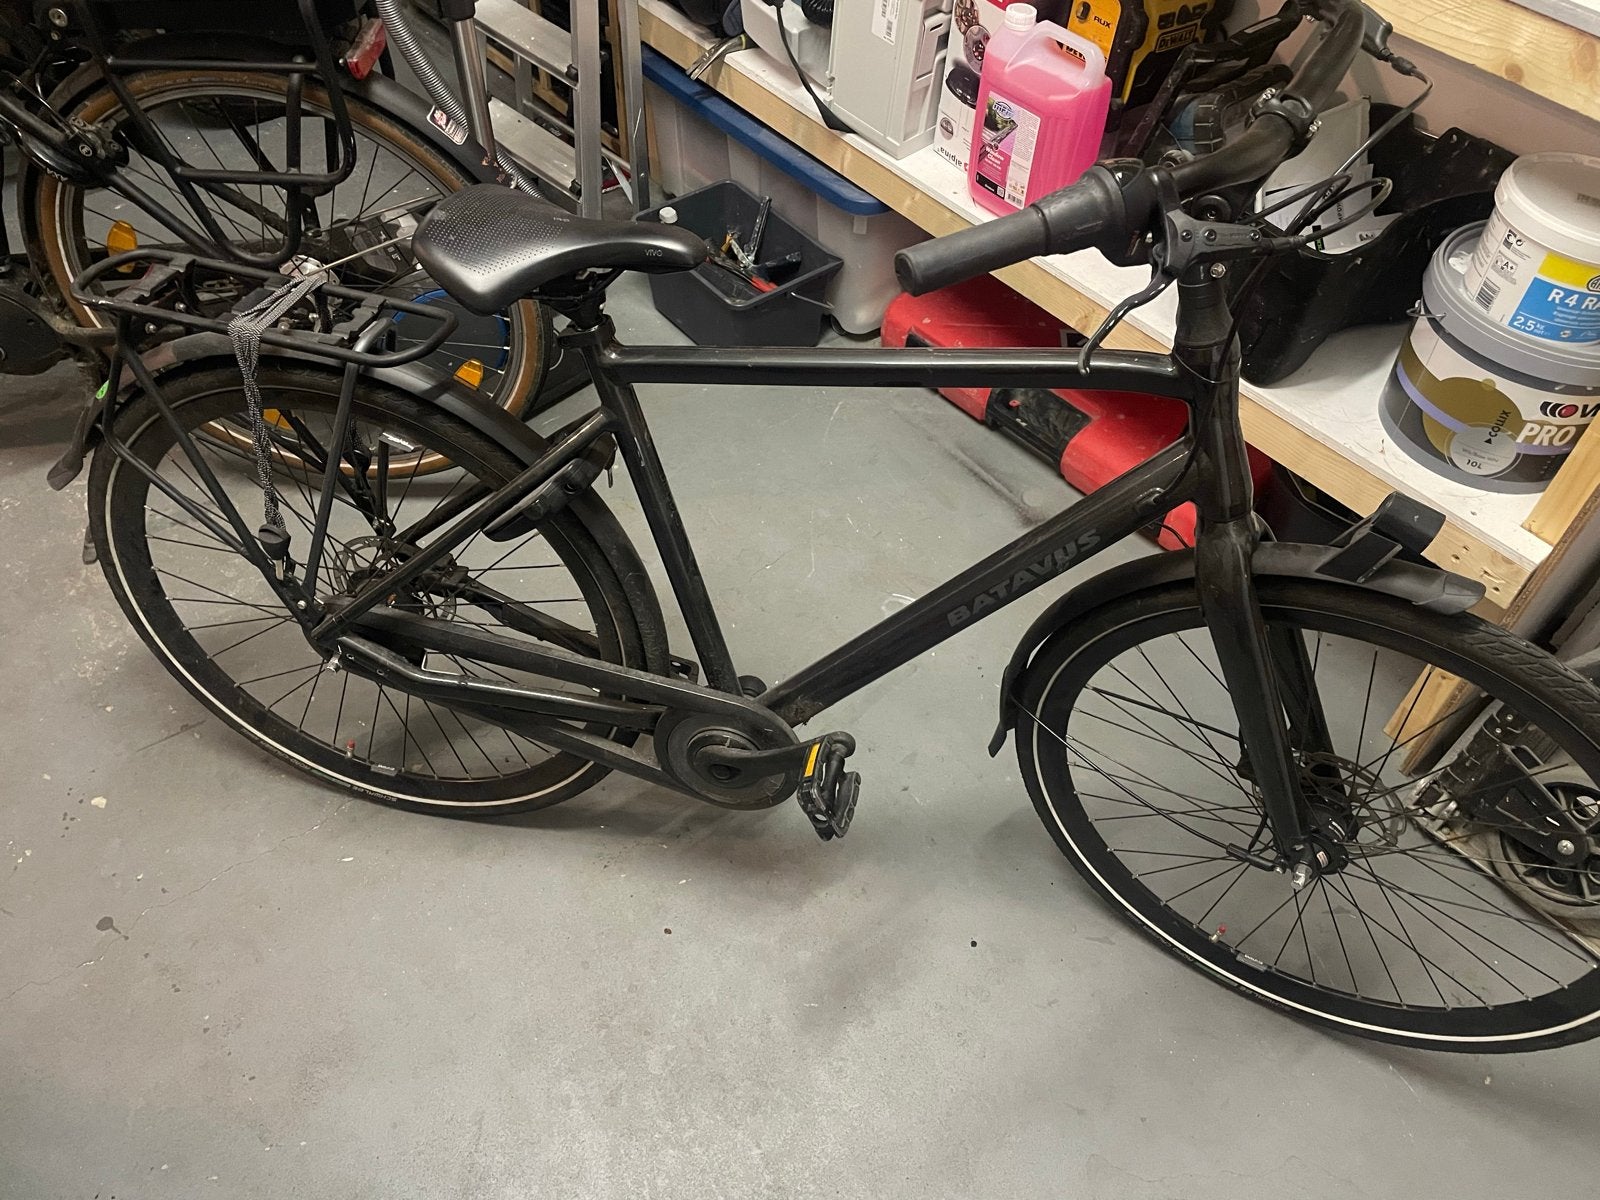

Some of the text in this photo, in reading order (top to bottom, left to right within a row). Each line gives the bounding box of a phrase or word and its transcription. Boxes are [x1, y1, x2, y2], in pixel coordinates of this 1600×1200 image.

[1093, 15, 1111, 29] AUX
[940, 146, 963, 167] alpina
[1547, 287, 1565, 304] R
[1564, 294, 1580, 308] 4
[1513, 315, 1537, 332] 2,5
[1515, 422, 1577, 447] PRO
[1466, 458, 1483, 470] 10L
[946, 528, 1101, 628] BATAVUS
